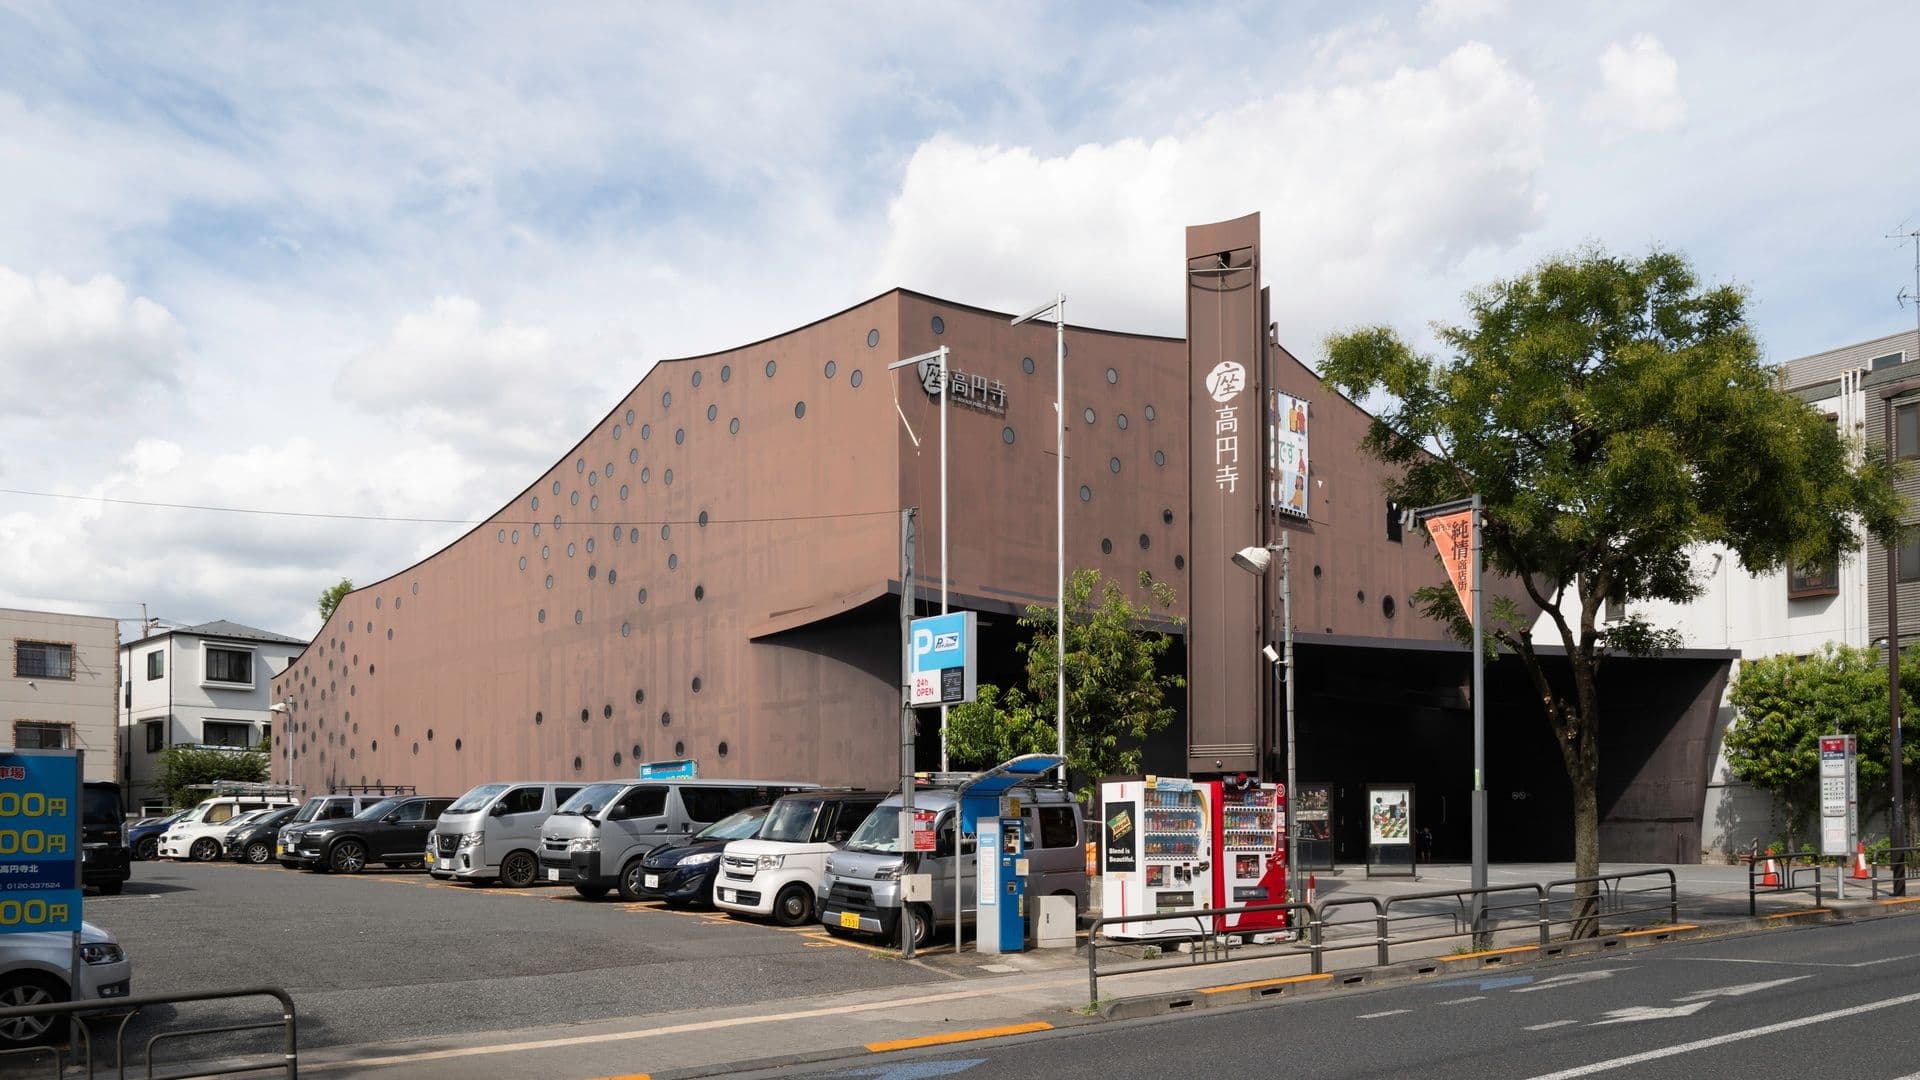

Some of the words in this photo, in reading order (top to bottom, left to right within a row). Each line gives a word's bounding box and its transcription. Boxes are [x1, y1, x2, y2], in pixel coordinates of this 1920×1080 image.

[951, 368, 1007, 407] 高円寺
[1211, 362, 1241, 397] 座
[1216, 405, 1239, 493] 高円寺
[914, 629, 933, 674] P
[916, 678, 928, 688] 24h
[916, 688, 934, 697] OPEN
[1109, 847, 1124, 855] Blend
